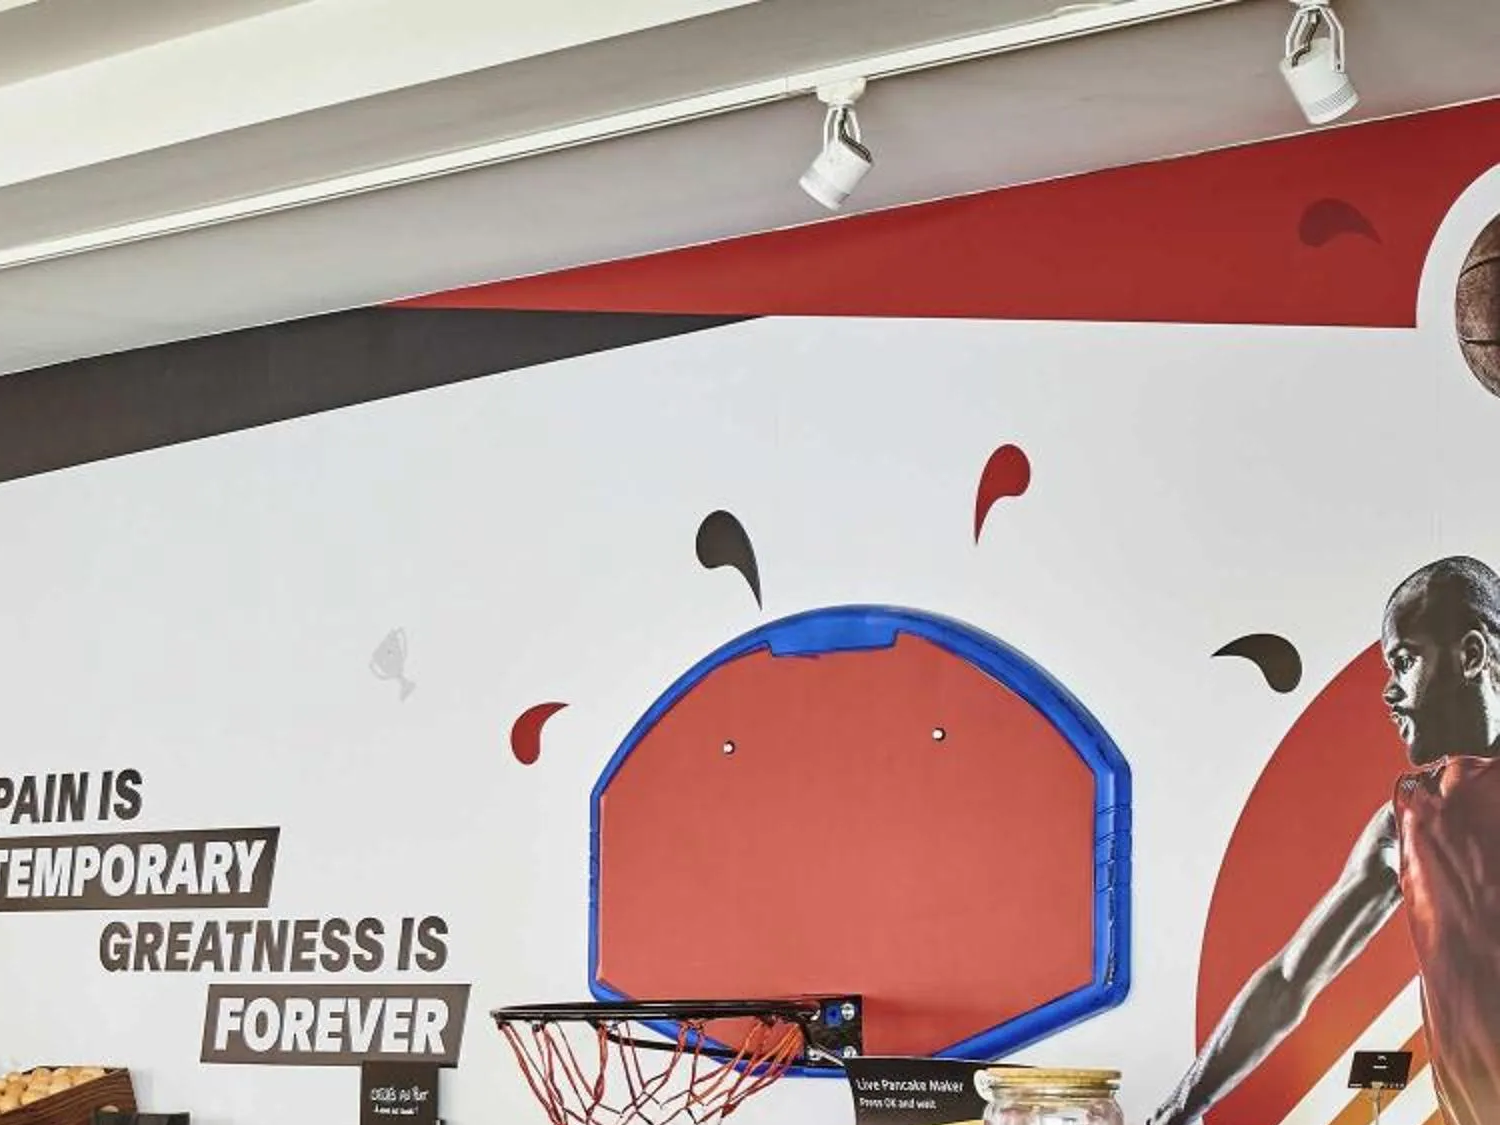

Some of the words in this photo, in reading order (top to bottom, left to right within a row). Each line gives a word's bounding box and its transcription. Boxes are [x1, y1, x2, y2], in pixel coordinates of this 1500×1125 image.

[97, 768, 143, 821] IS
[99, 917, 385, 973] GREATNESS
[398, 915, 449, 972] IS
[213, 997, 448, 1055] FOREVER
[856, 1078, 880, 1091] Live
[882, 1079, 927, 1092] Pancake
[929, 1080, 964, 1093] Maker
[859, 1097, 882, 1108] Press
[883, 1098, 896, 1108] OK
[899, 1099, 914, 1109] and
